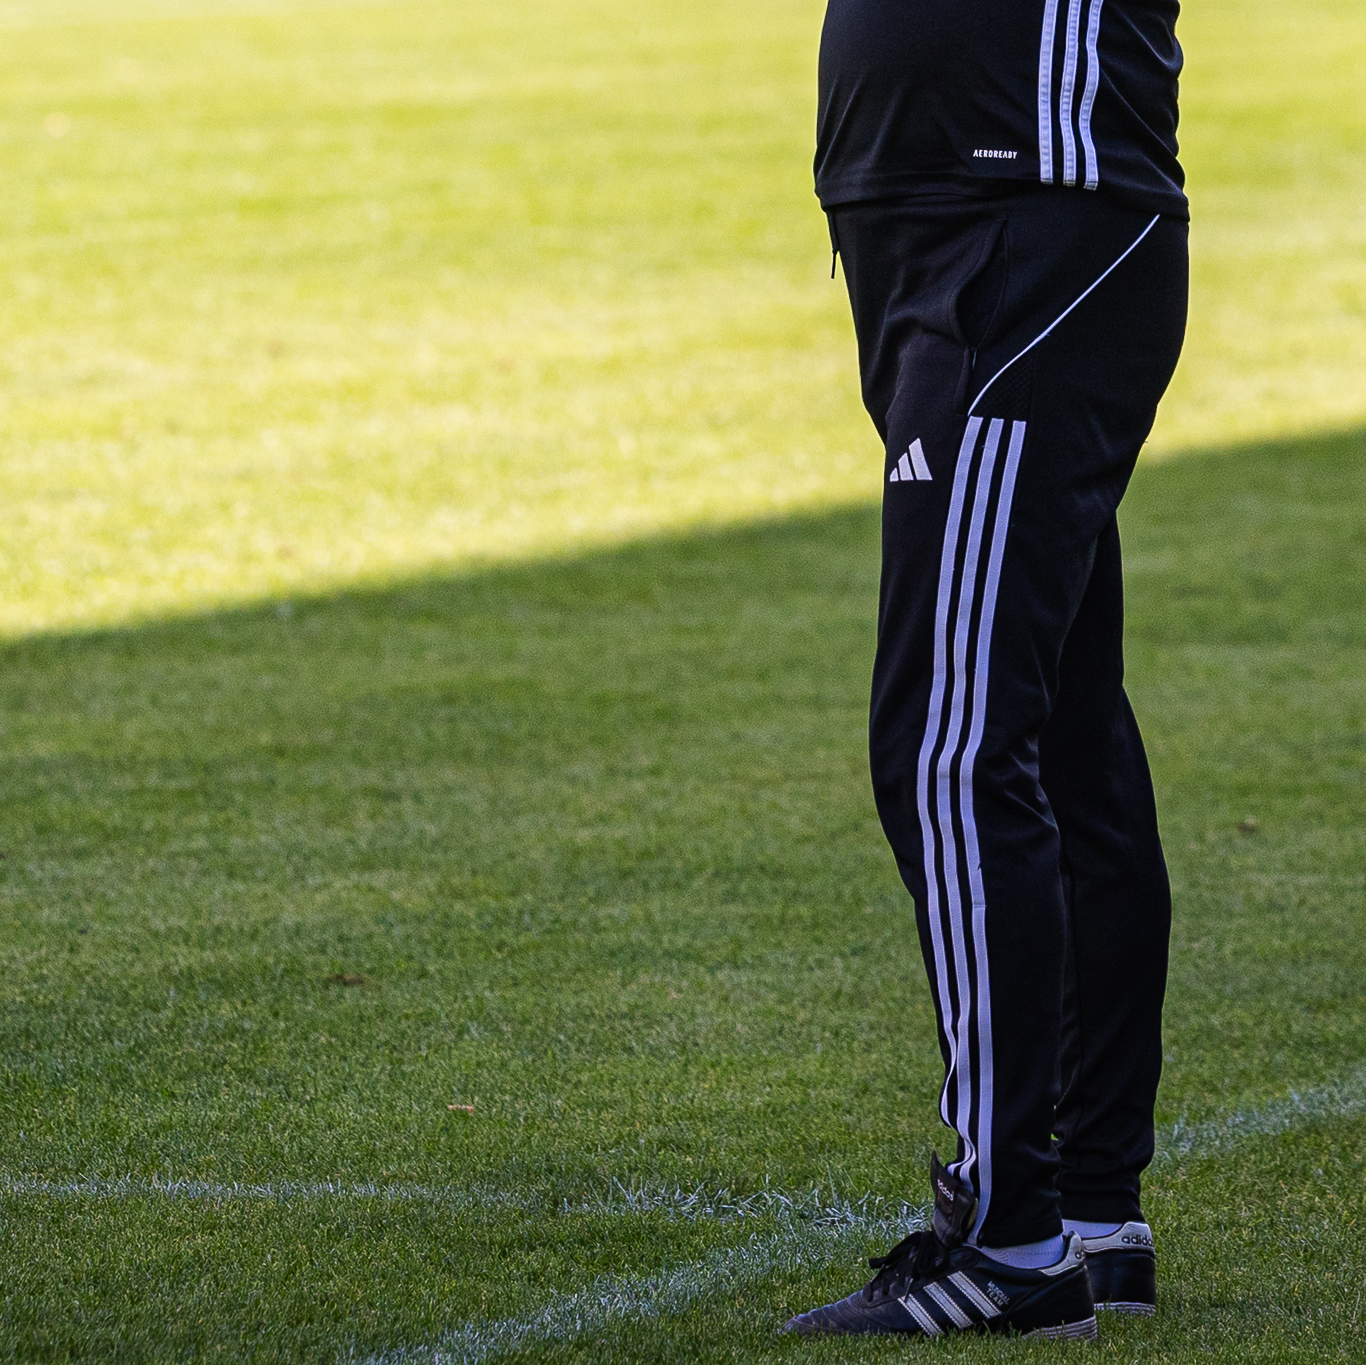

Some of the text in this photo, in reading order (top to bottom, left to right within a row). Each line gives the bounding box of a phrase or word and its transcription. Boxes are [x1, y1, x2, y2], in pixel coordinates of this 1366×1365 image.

[972, 148, 1018, 160] AEROREADY
[1121, 1234, 1154, 1247] adida
[986, 1287, 1004, 1307] TEAM
